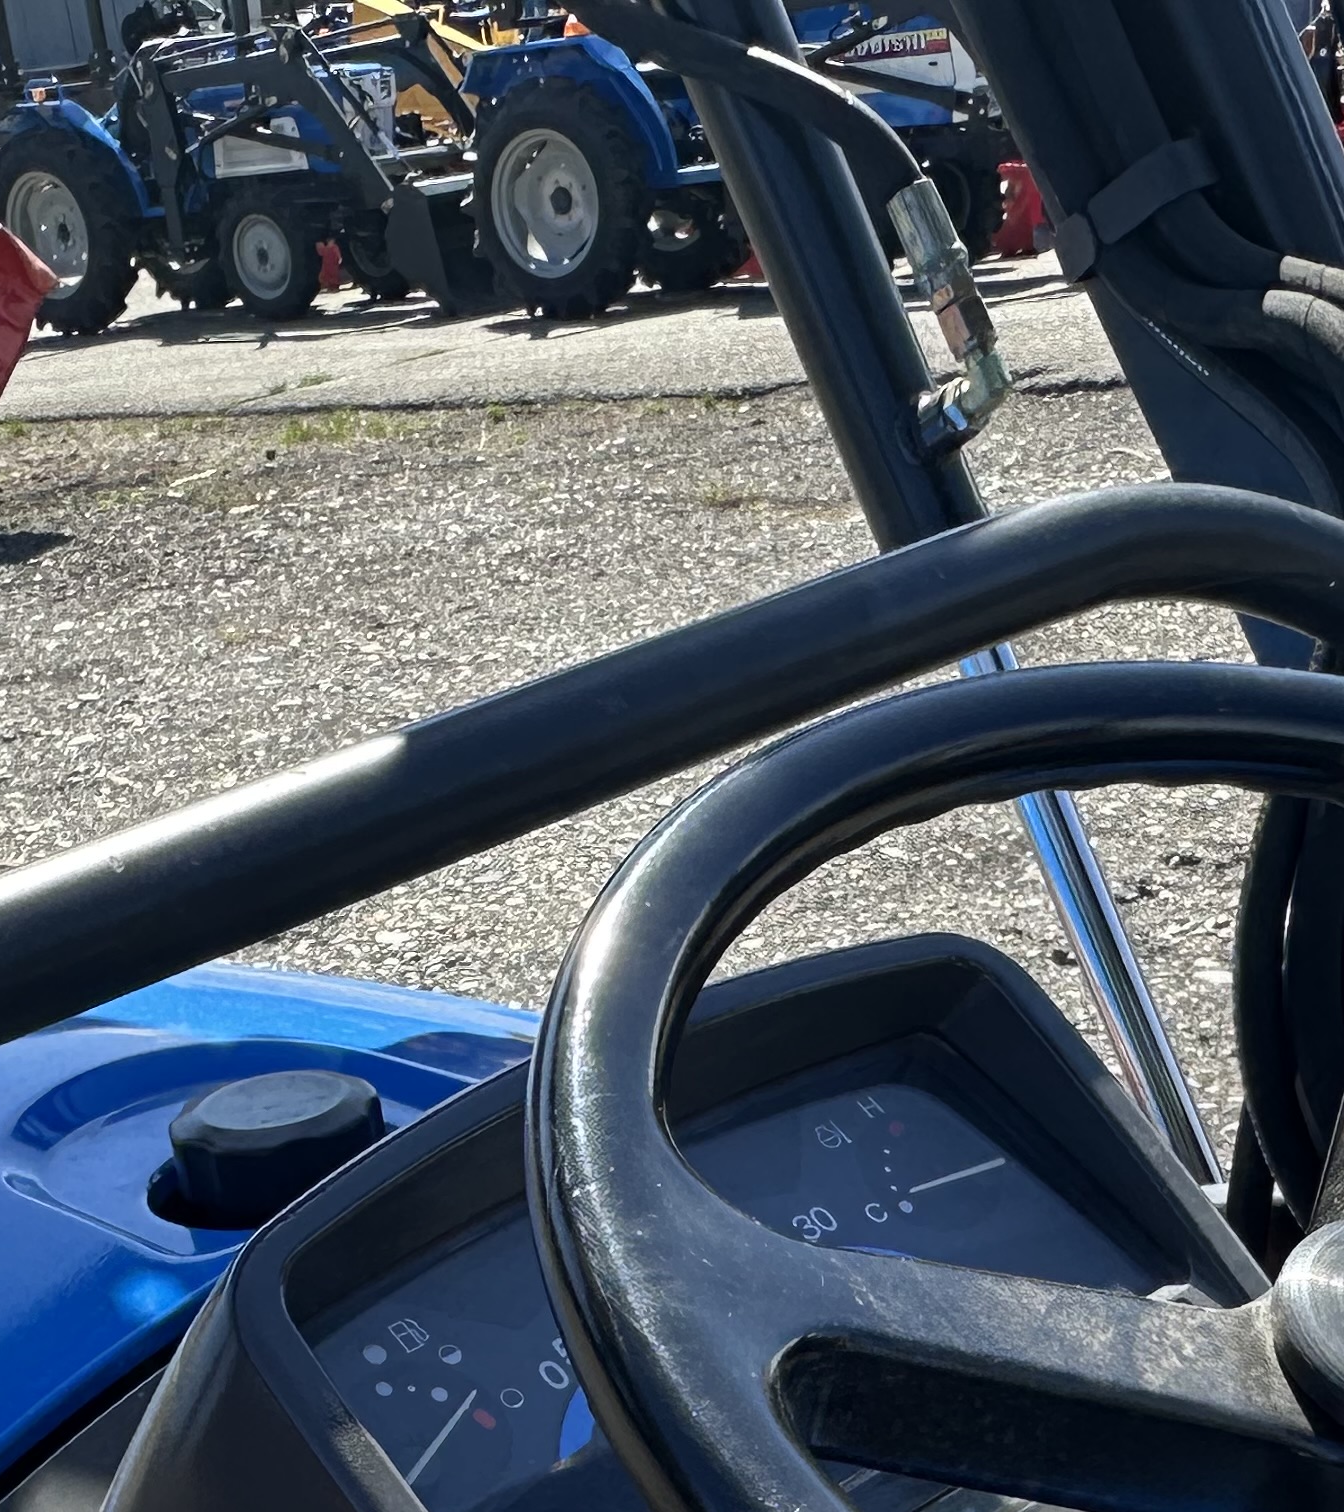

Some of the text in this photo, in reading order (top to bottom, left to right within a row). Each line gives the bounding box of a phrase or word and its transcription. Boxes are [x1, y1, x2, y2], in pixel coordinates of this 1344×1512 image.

[856, 1096, 886, 1119] H
[791, 1206, 838, 1240] 30
[864, 1202, 889, 1223] C
[538, 1360, 570, 1390] 0
